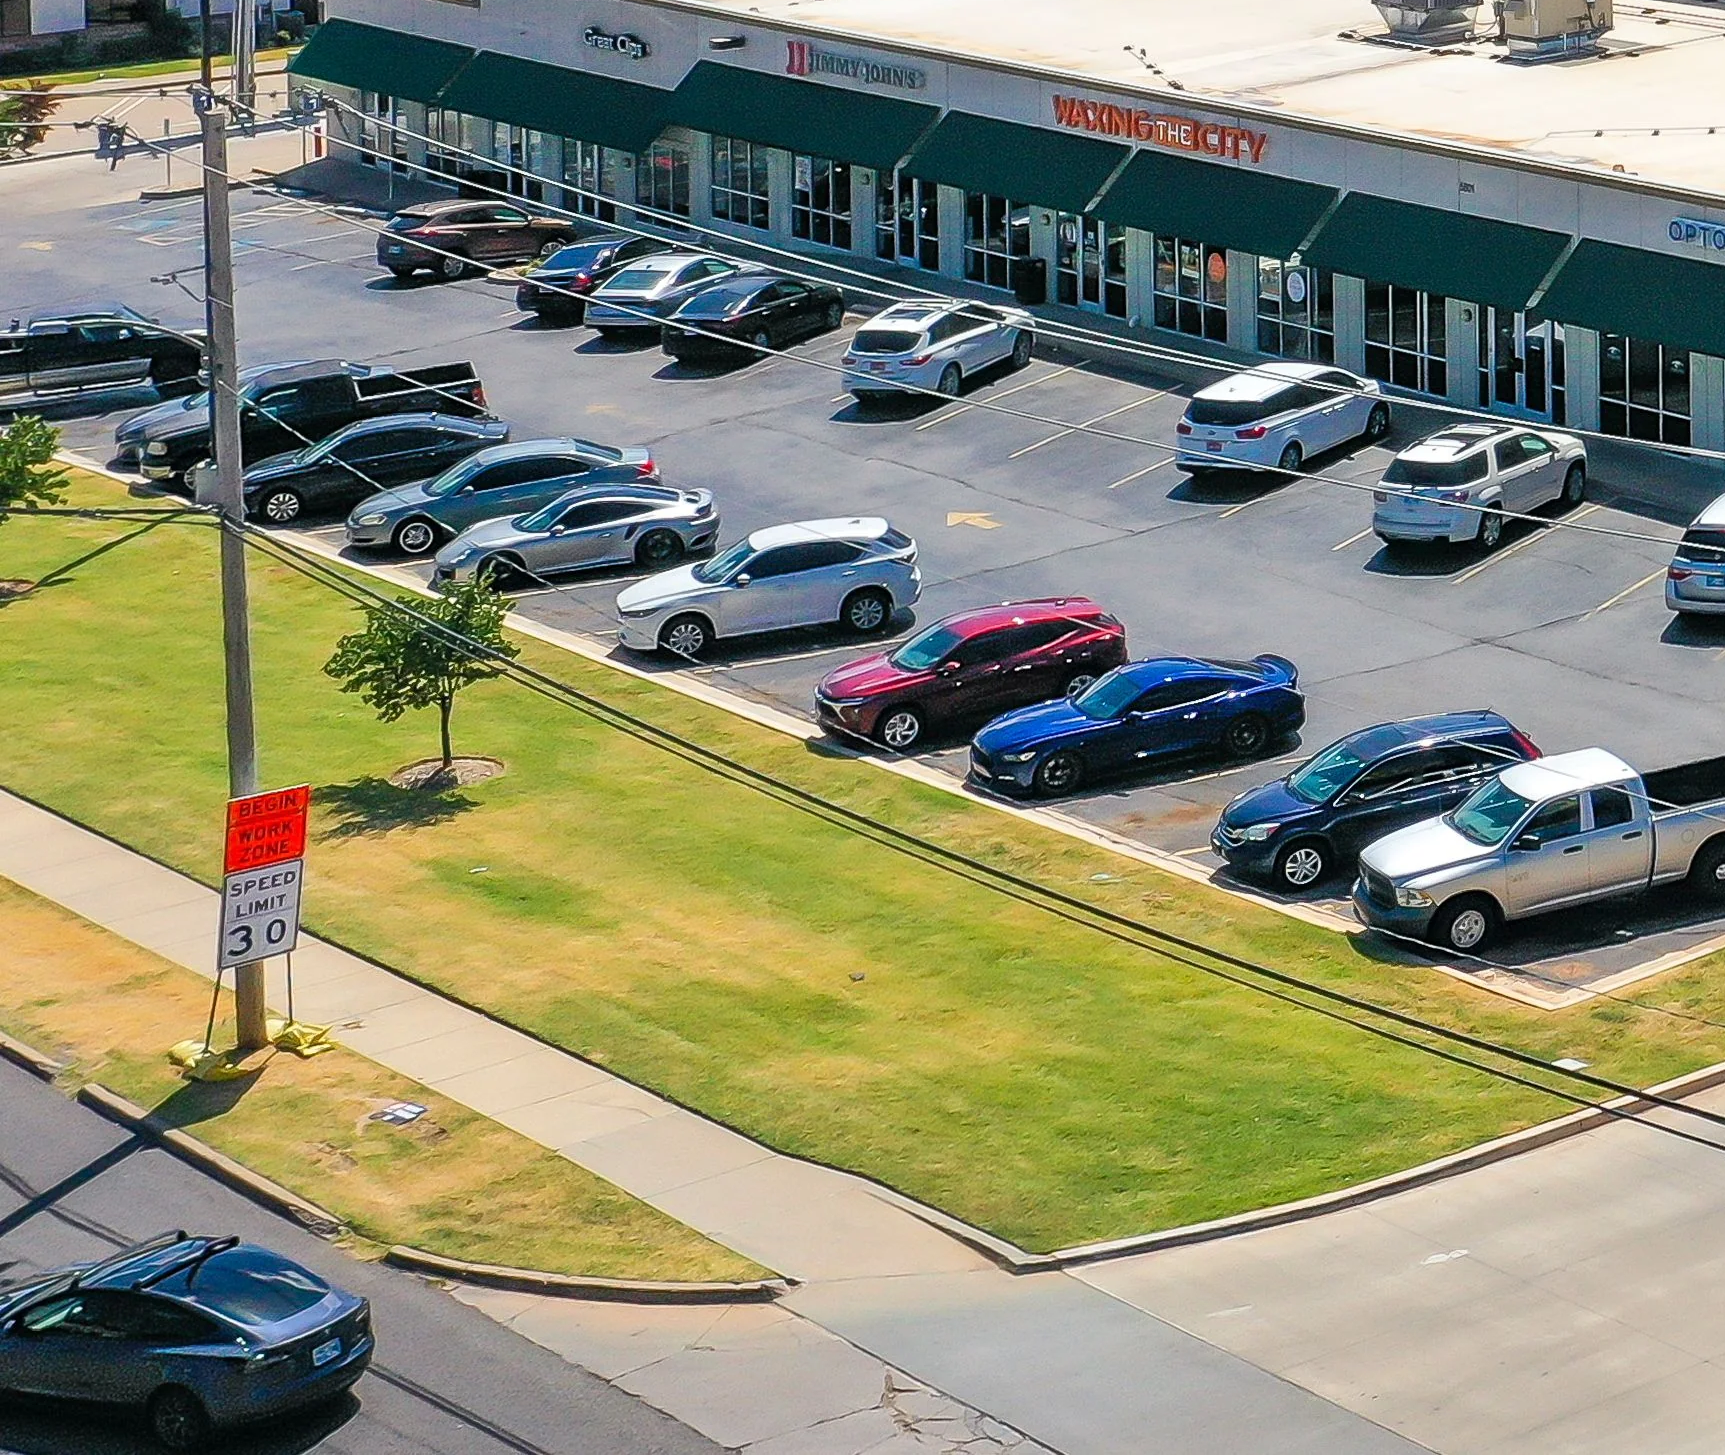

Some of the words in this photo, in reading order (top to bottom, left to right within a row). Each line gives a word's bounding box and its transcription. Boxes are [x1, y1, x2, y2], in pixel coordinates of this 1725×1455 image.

[583, 28, 614, 51] Great
[809, 51, 860, 78] JIMMY
[860, 62, 920, 89] JOHN'S
[1052, 94, 1153, 141] WAXING
[1156, 120, 1192, 146] THE
[1198, 122, 1268, 164] CITY
[239, 793, 298, 818] BEGIN
[239, 820, 293, 844] WORK
[239, 839, 290, 863] ZONE
[230, 869, 296, 896] SPEED
[235, 893, 287, 918] LIMIT
[226, 918, 287, 957] 30
